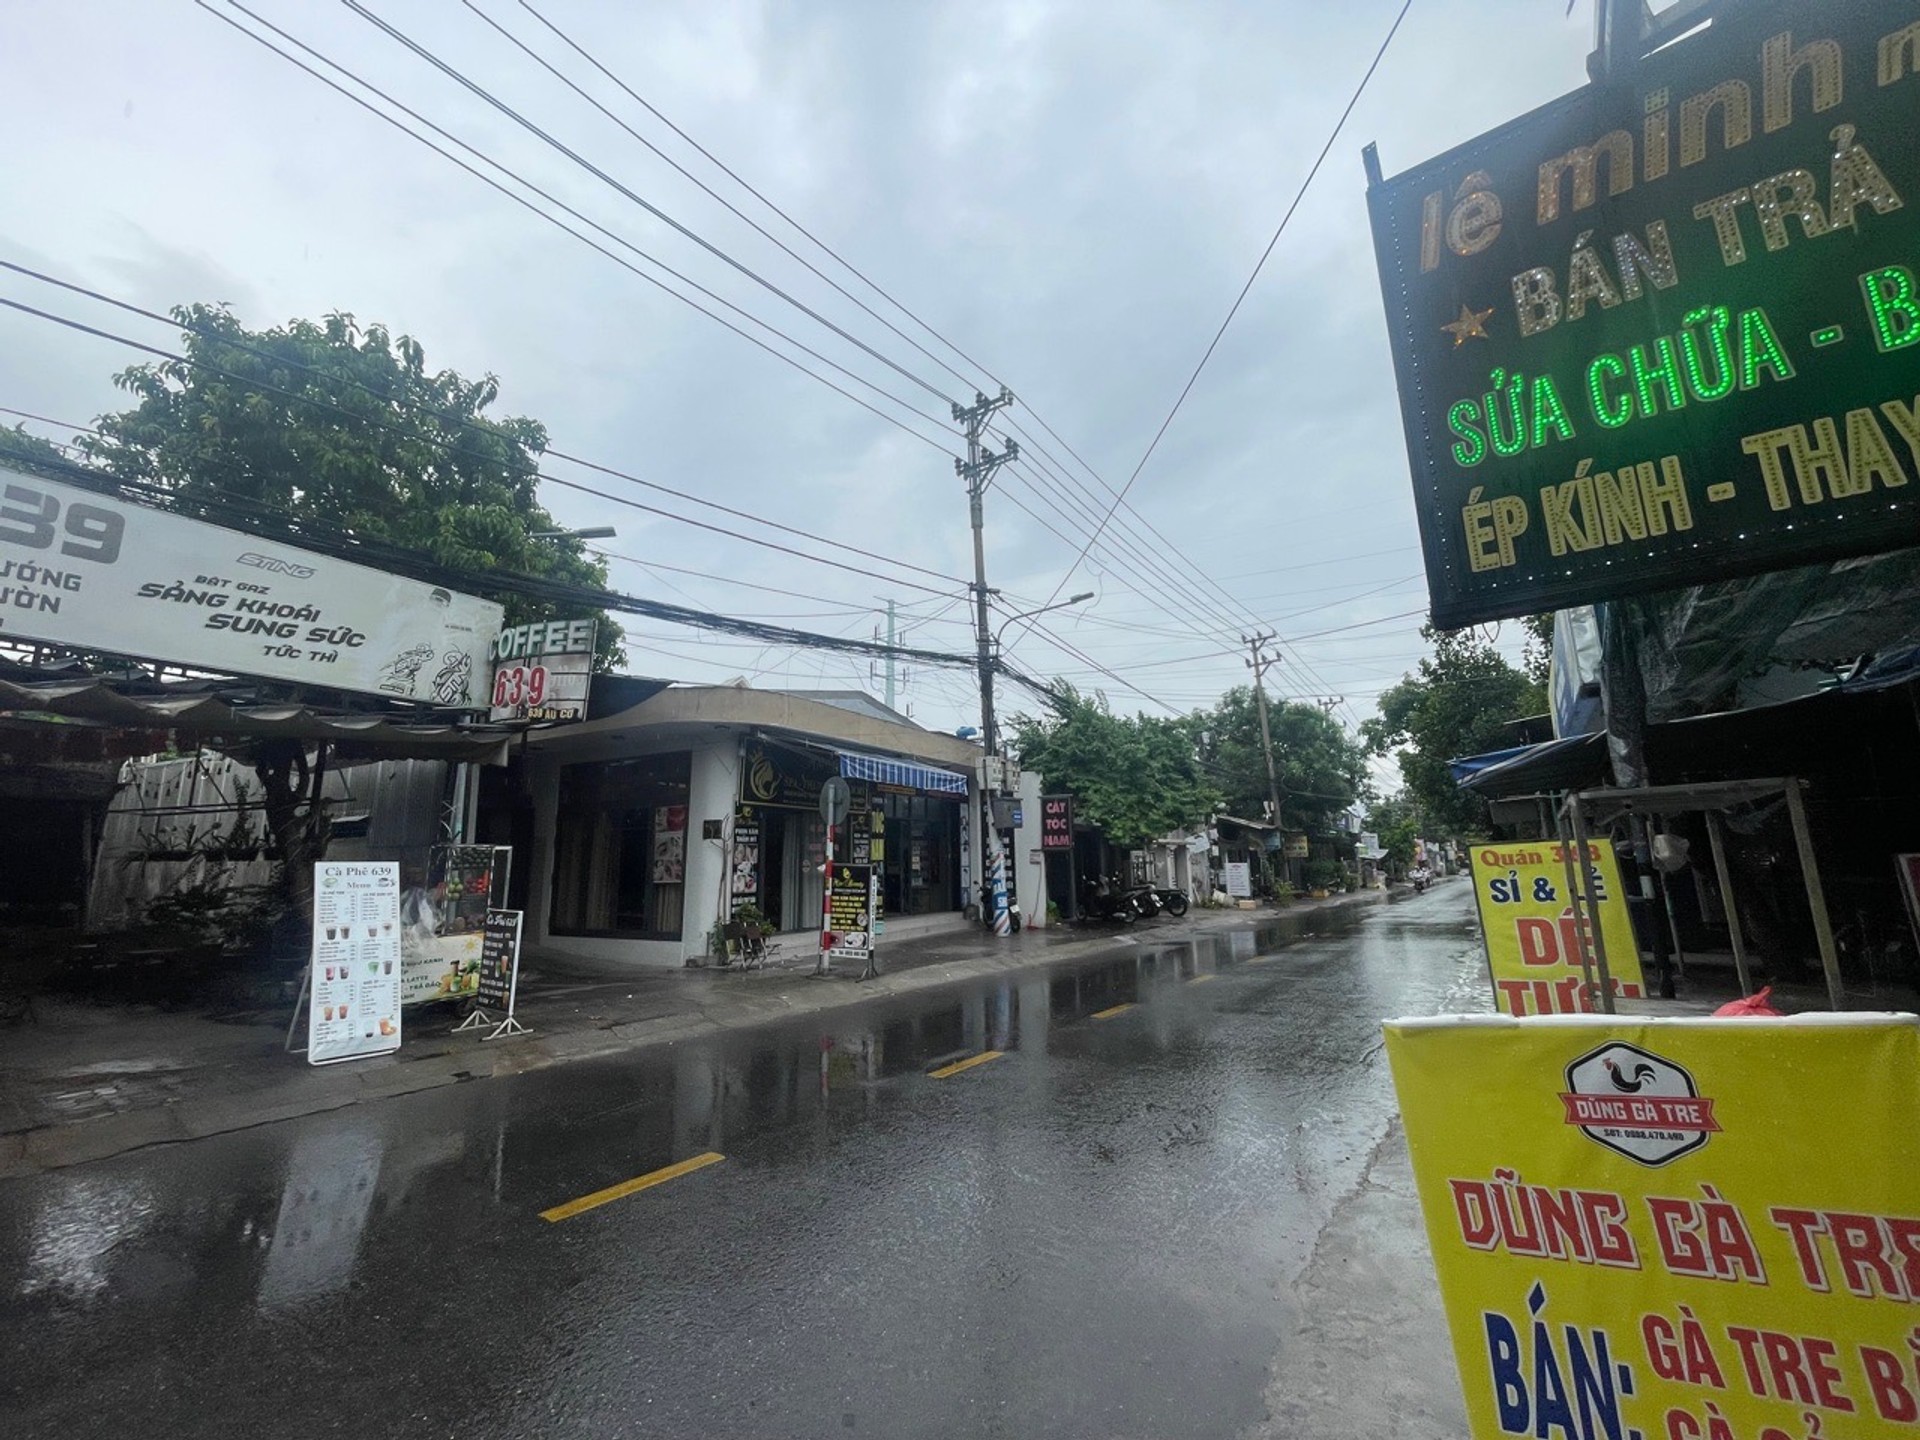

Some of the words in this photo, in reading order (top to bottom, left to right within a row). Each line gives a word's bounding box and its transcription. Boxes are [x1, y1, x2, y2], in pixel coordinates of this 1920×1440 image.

[1420, 170, 1503, 273] lê
[1537, 30, 1843, 227] minh
[1511, 220, 1679, 337] BÁN
[1693, 123, 1903, 266] TRẢ
[1447, 367, 1575, 467] SỬA
[1585, 304, 1796, 429] CHỮA
[1462, 485, 1529, 573] ÉP
[1540, 456, 1694, 557] KÍNH
[236, 552, 317, 579] STING
[137, 580, 230, 608] SẢNG
[236, 597, 322, 623] KHOÁI
[205, 613, 300, 639] SUNG
[305, 625, 366, 648] SỨC
[488, 619, 589, 662] COFFEE
[492, 665, 550, 708] 639
[1044, 835, 1070, 846] NAM
[1480, 850, 1543, 868] Quán
[371, 867, 391, 876] 639
[1489, 870, 1521, 902] SỈ
[1533, 877, 1556, 901] &
[1569, 866, 1608, 900] Ẻ
[1662, 1104, 1703, 1123] TRE
[1449, 1168, 1642, 1270] DŨNG
[1646, 1183, 1770, 1286] GÀ
[1641, 1305, 1726, 1390] GÀ
[1727, 1326, 1856, 1413] TRE
[1859, 1327, 1920, 1423] B
